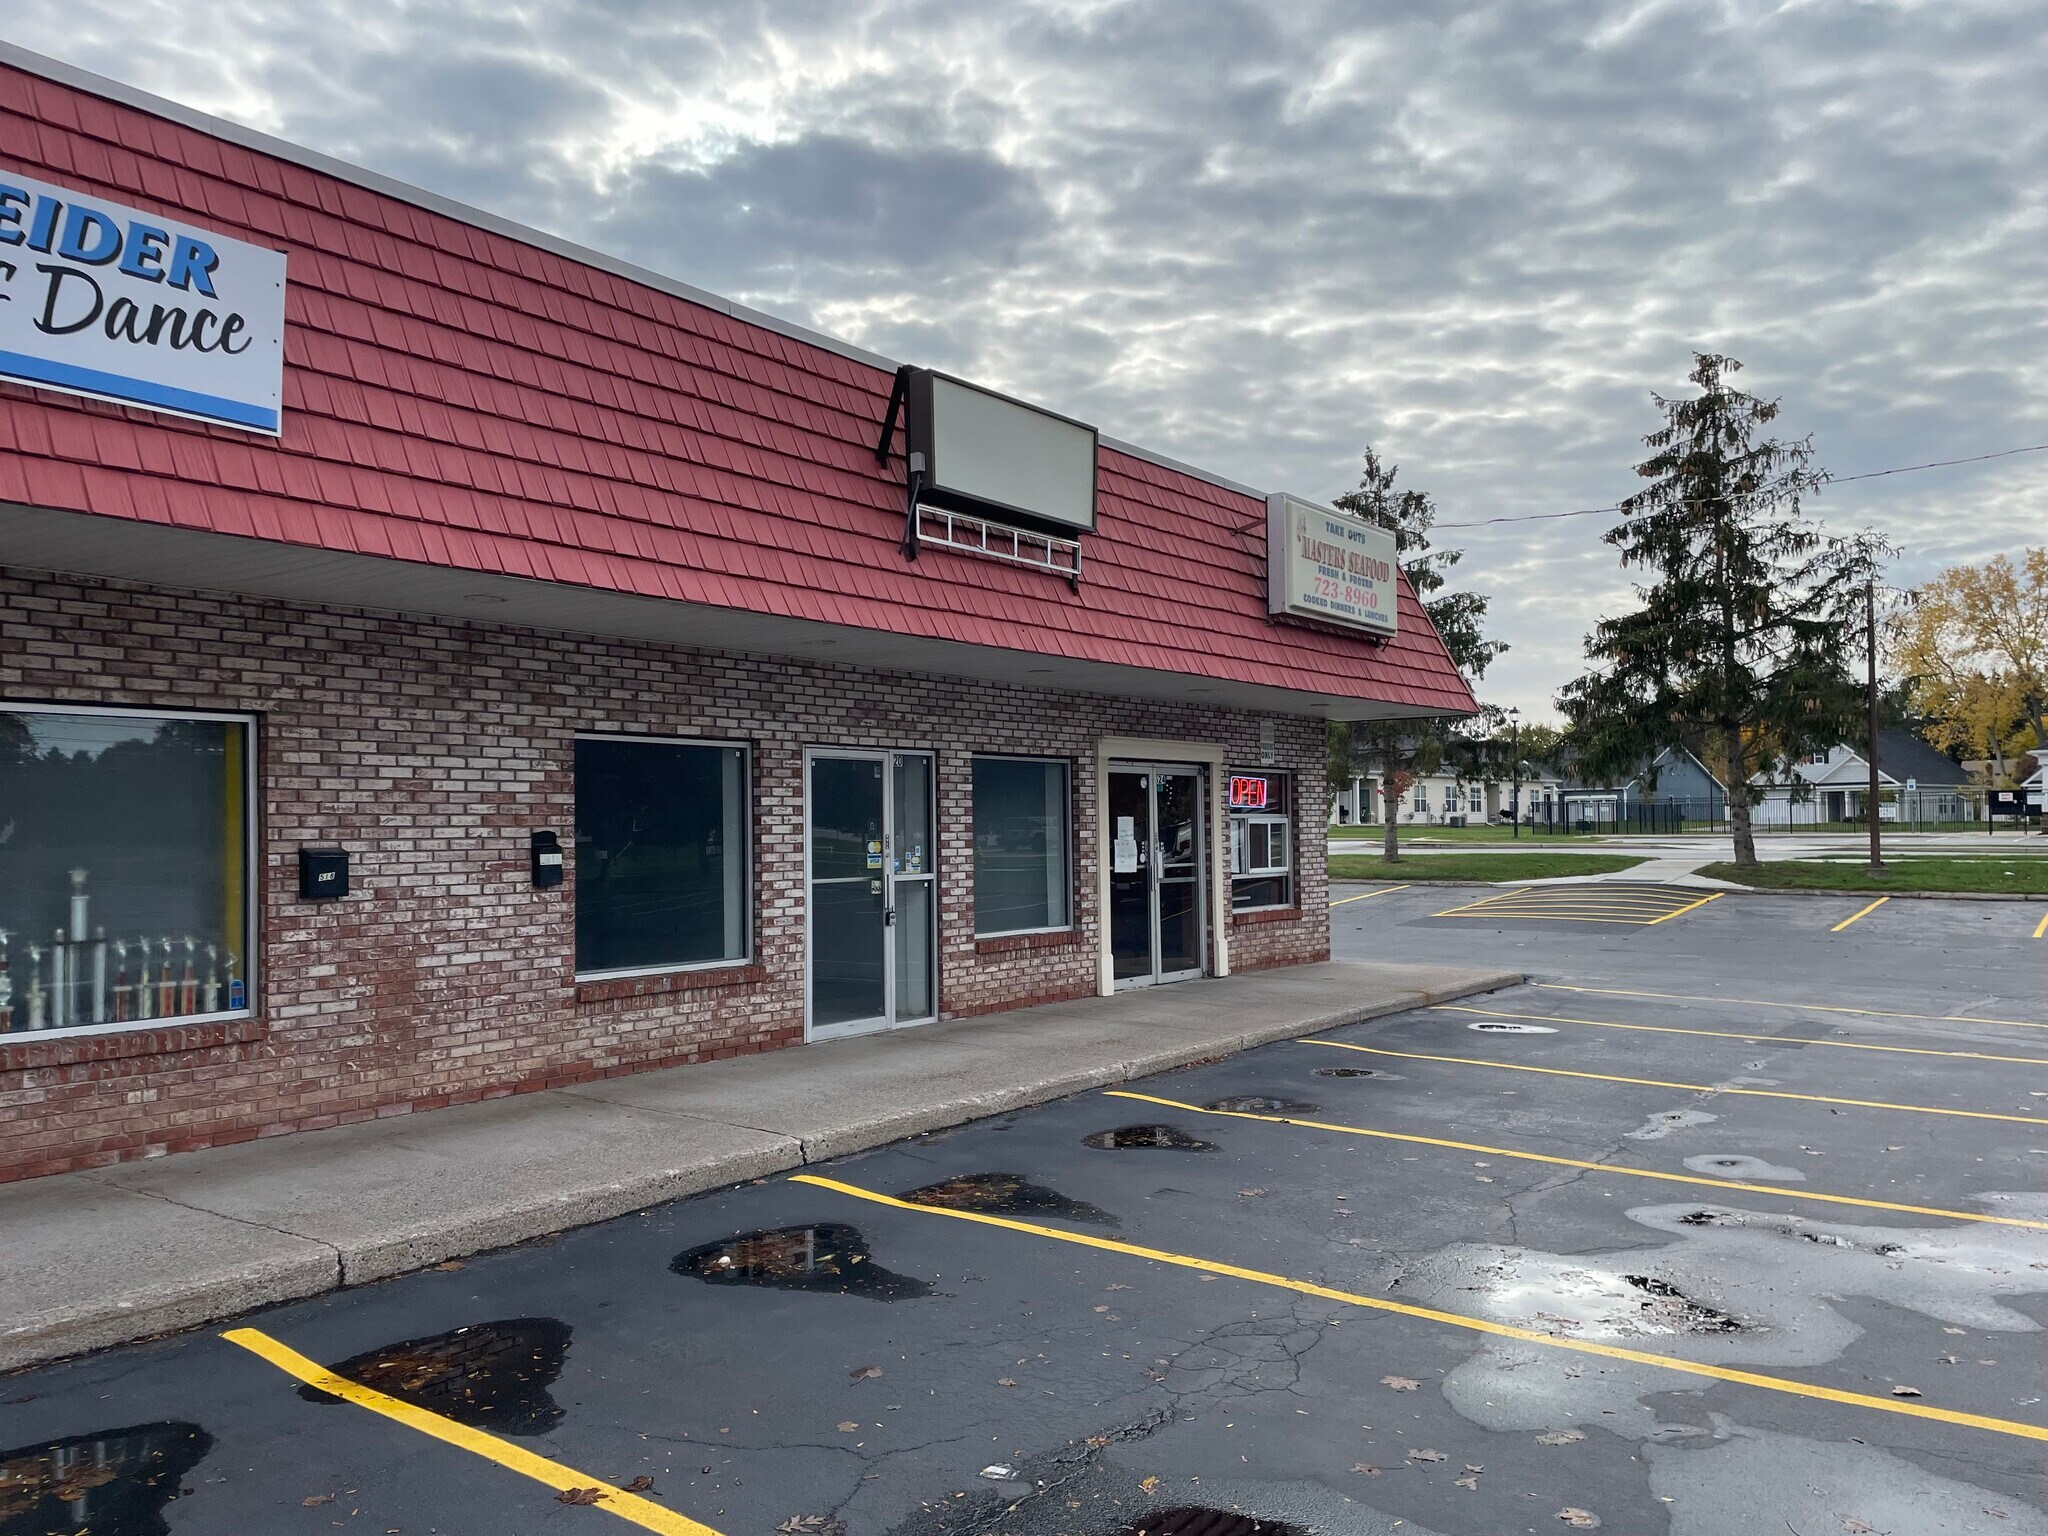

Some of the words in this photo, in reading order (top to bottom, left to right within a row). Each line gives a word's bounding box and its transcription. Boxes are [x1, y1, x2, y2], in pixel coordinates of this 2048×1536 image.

[33, 262, 252, 355] Dance
[1326, 521, 1344, 537] TAKE
[1348, 529, 1366, 544] OUTS
[1301, 535, 1346, 570] MASTERS
[1348, 551, 1390, 583] SEAFOOD
[1318, 565, 1339, 579] FRESH
[1342, 572, 1346, 582] &
[1349, 574, 1373, 589] FROZEN
[1303, 593, 1328, 607] COOKED
[1330, 600, 1355, 615] DINNERS
[1358, 608, 1362, 616] &
[1364, 609, 1388, 623] LUNCHES
[1314, 577, 1378, 609] 723-8960
[1231, 778, 1265, 807] OPEN
